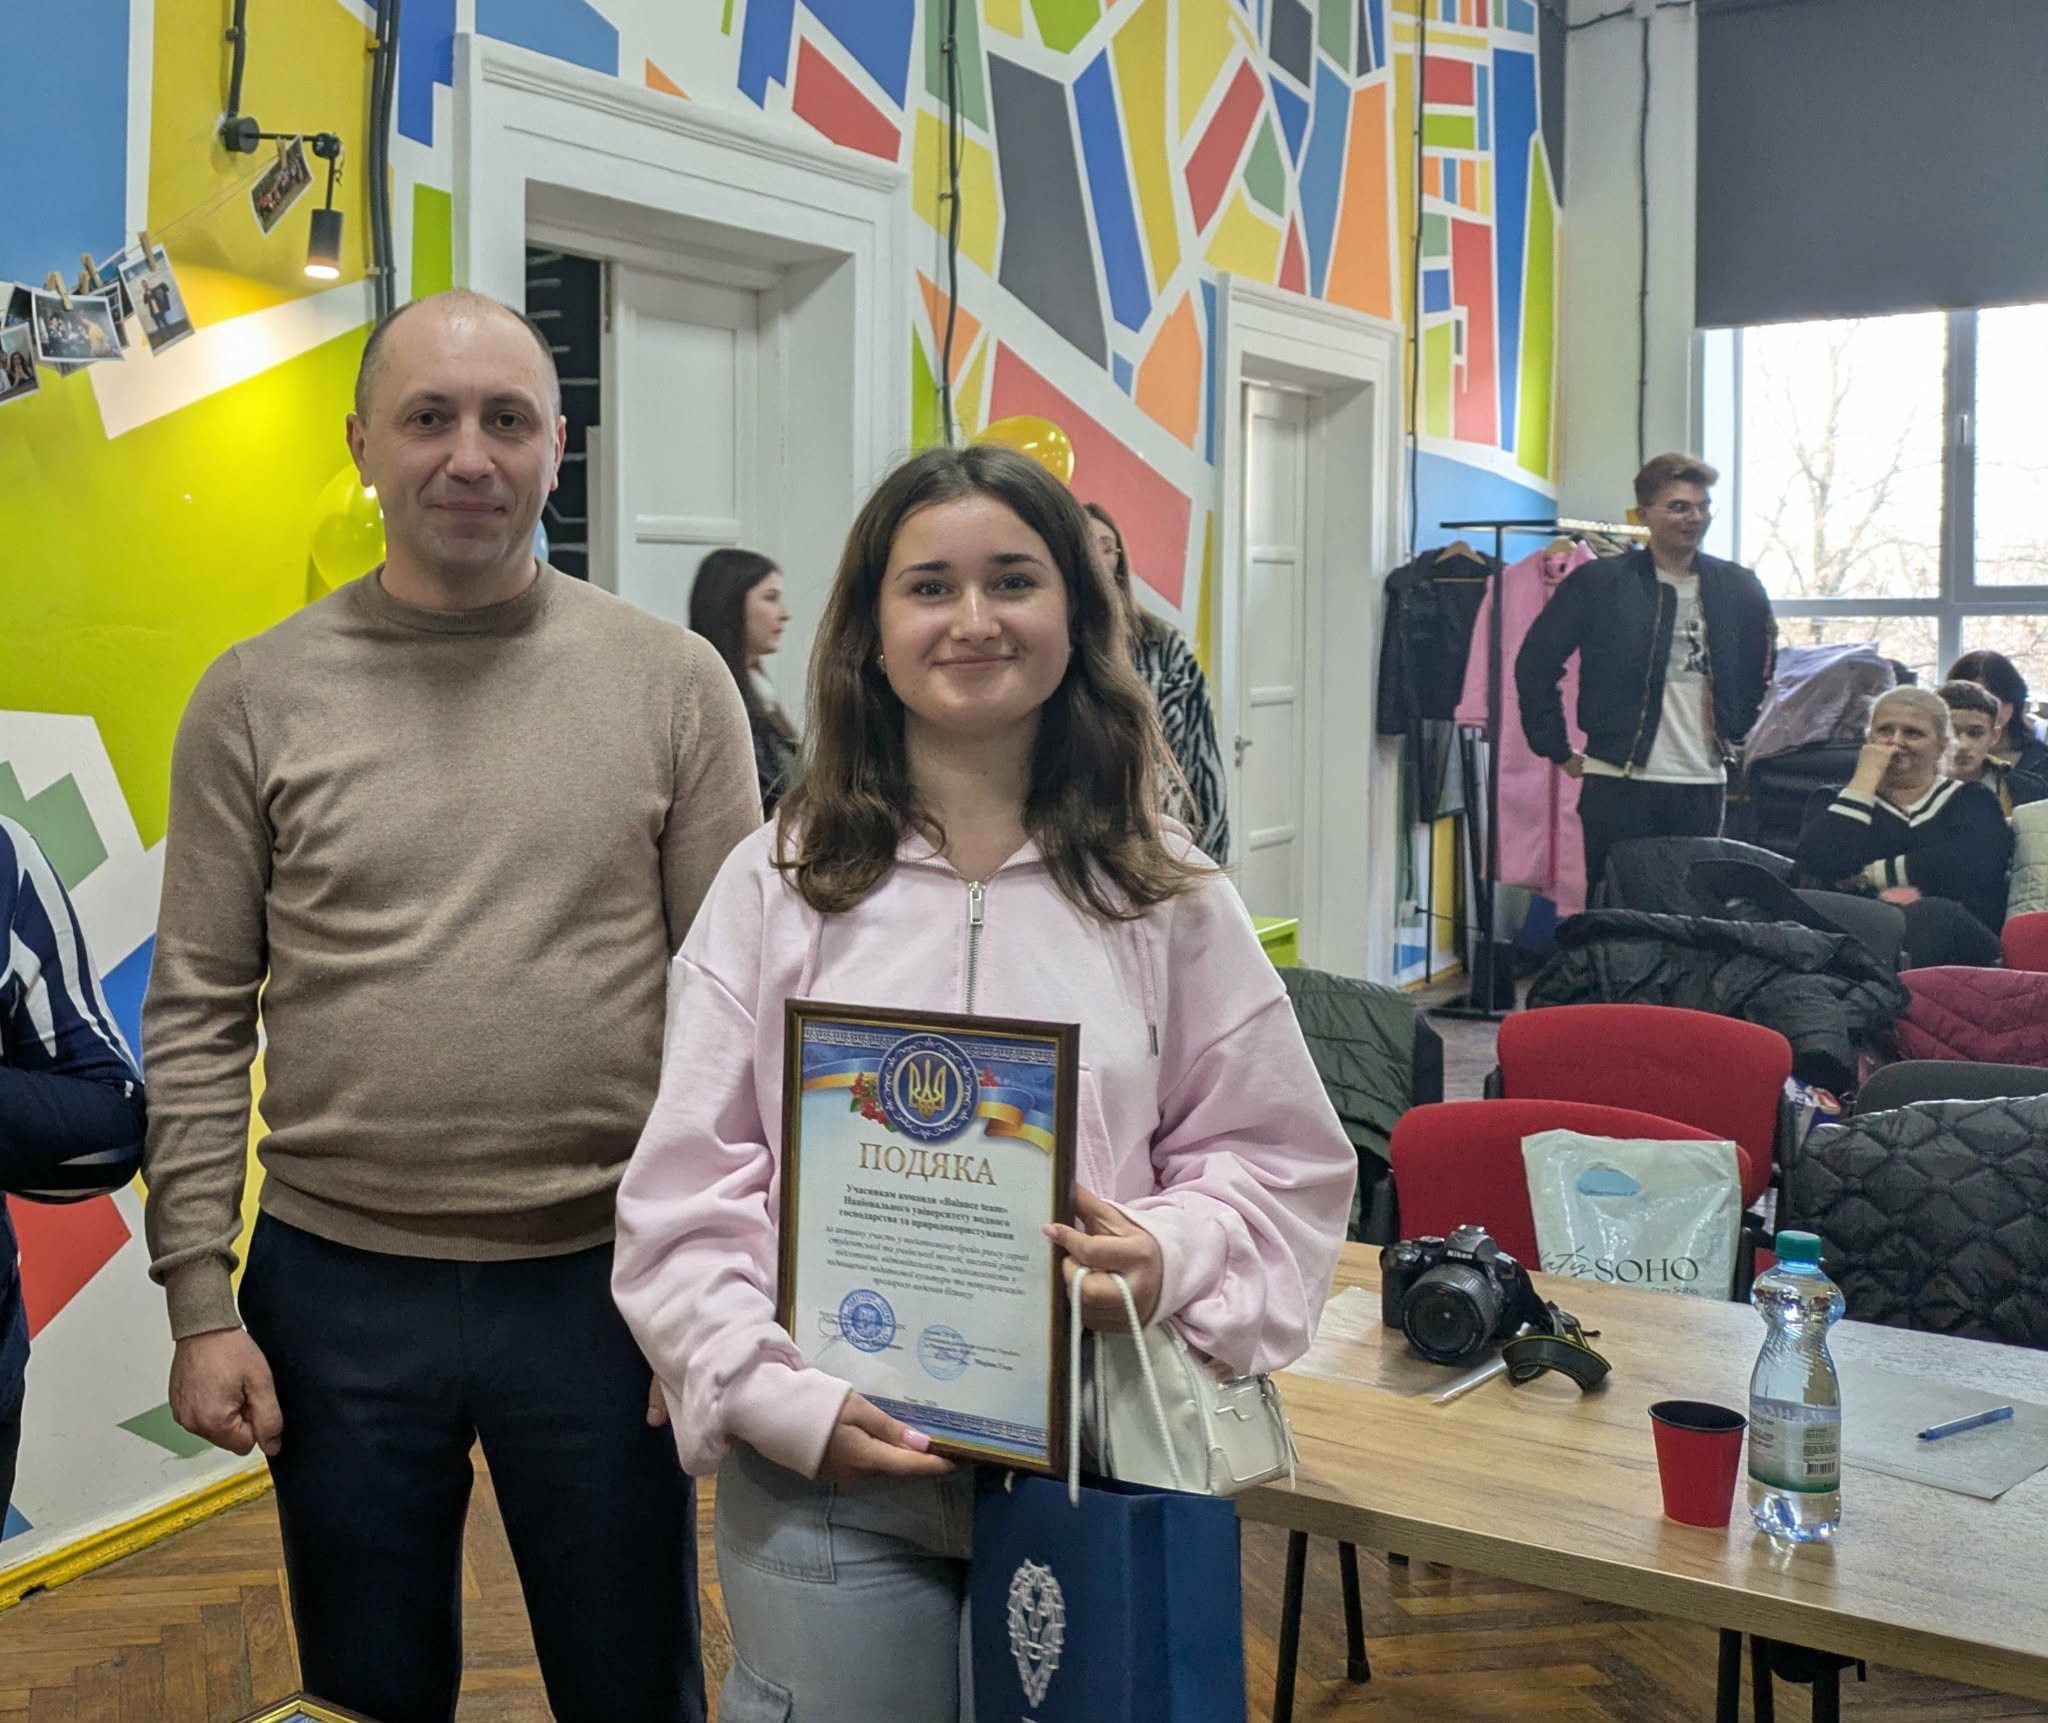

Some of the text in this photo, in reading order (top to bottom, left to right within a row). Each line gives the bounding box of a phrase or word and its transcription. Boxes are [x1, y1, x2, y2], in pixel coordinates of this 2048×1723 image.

[859, 1142, 998, 1186] ПОДЯКА
[846, 1183, 897, 1199] Учасникам
[839, 1208, 898, 1223] господарства
[911, 1219, 1014, 1240] природокористування
[844, 1195, 911, 1213] Національного
[911, 1207, 970, 1225] університету
[1595, 1256, 1699, 1283] SOHO
